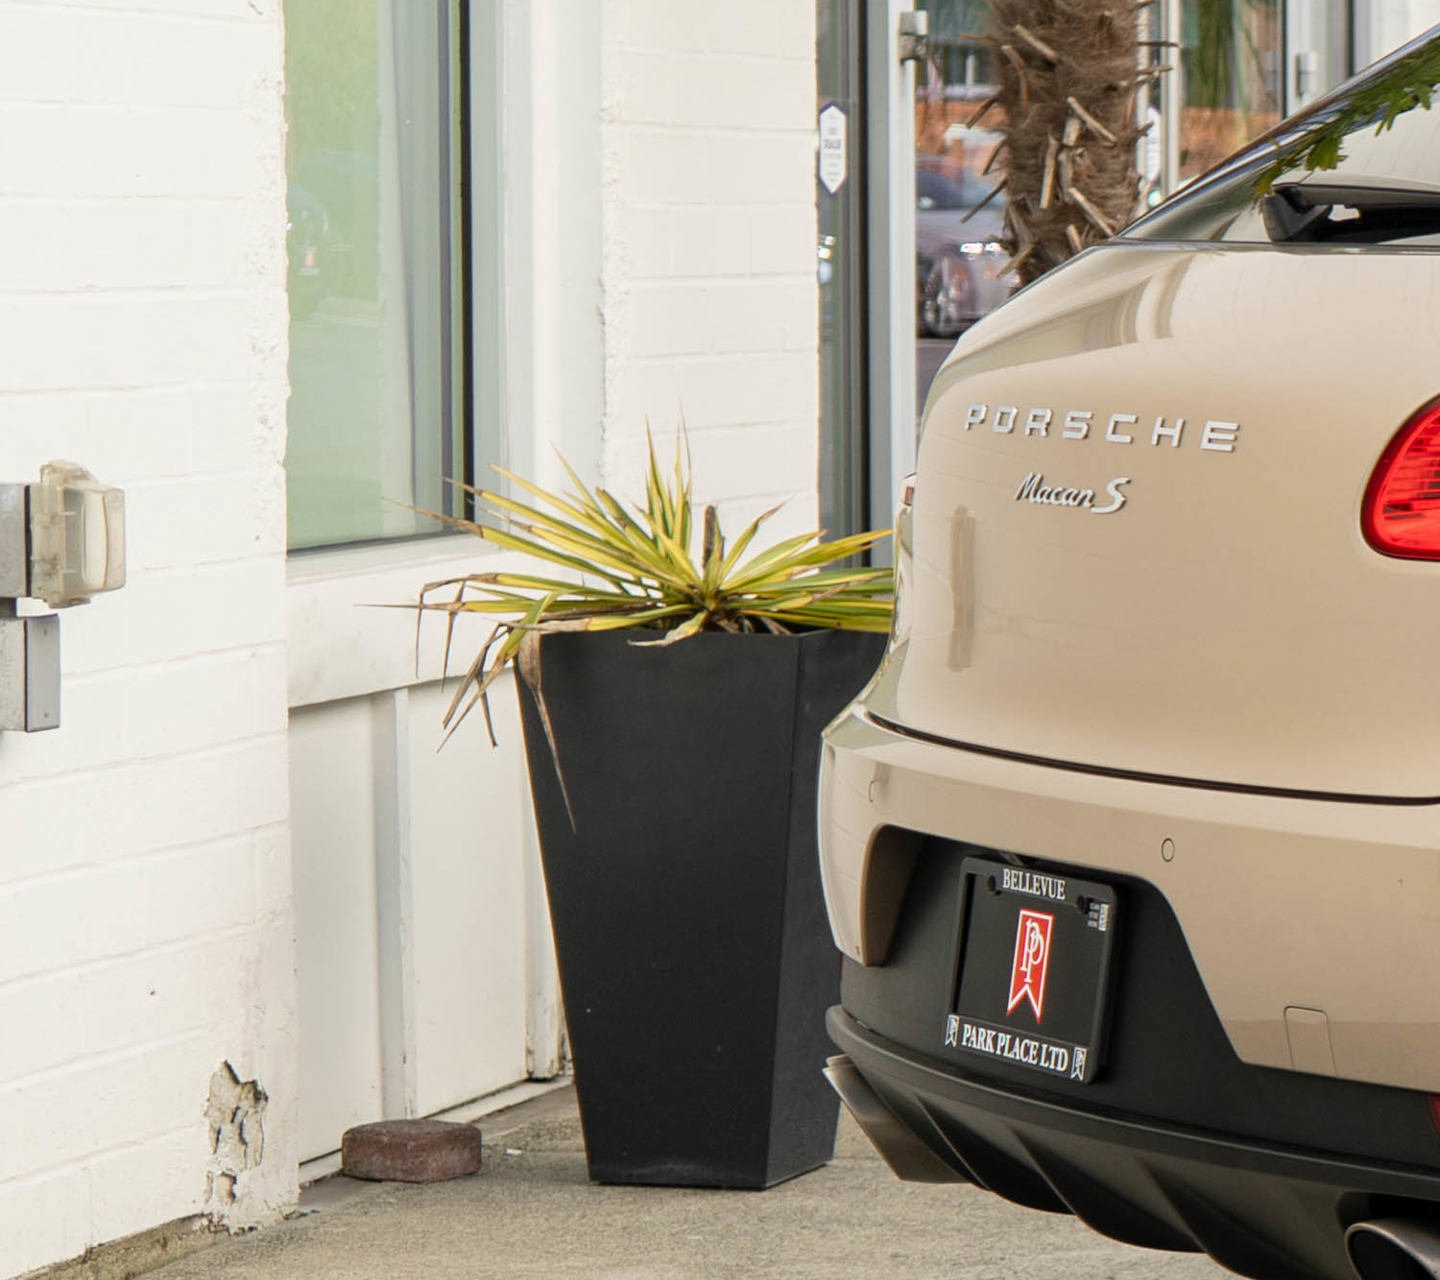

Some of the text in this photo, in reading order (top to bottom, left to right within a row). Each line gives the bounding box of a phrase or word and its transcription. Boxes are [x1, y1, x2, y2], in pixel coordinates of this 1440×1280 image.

[964, 404, 1241, 453] PORSCHE
[1013, 471, 1132, 514] Macan S
[1002, 868, 1066, 900] BELLEVUE
[961, 1023, 996, 1054] PARK
[997, 1031, 1039, 1064] PLACE
[1040, 1042, 1069, 1072] LTD
